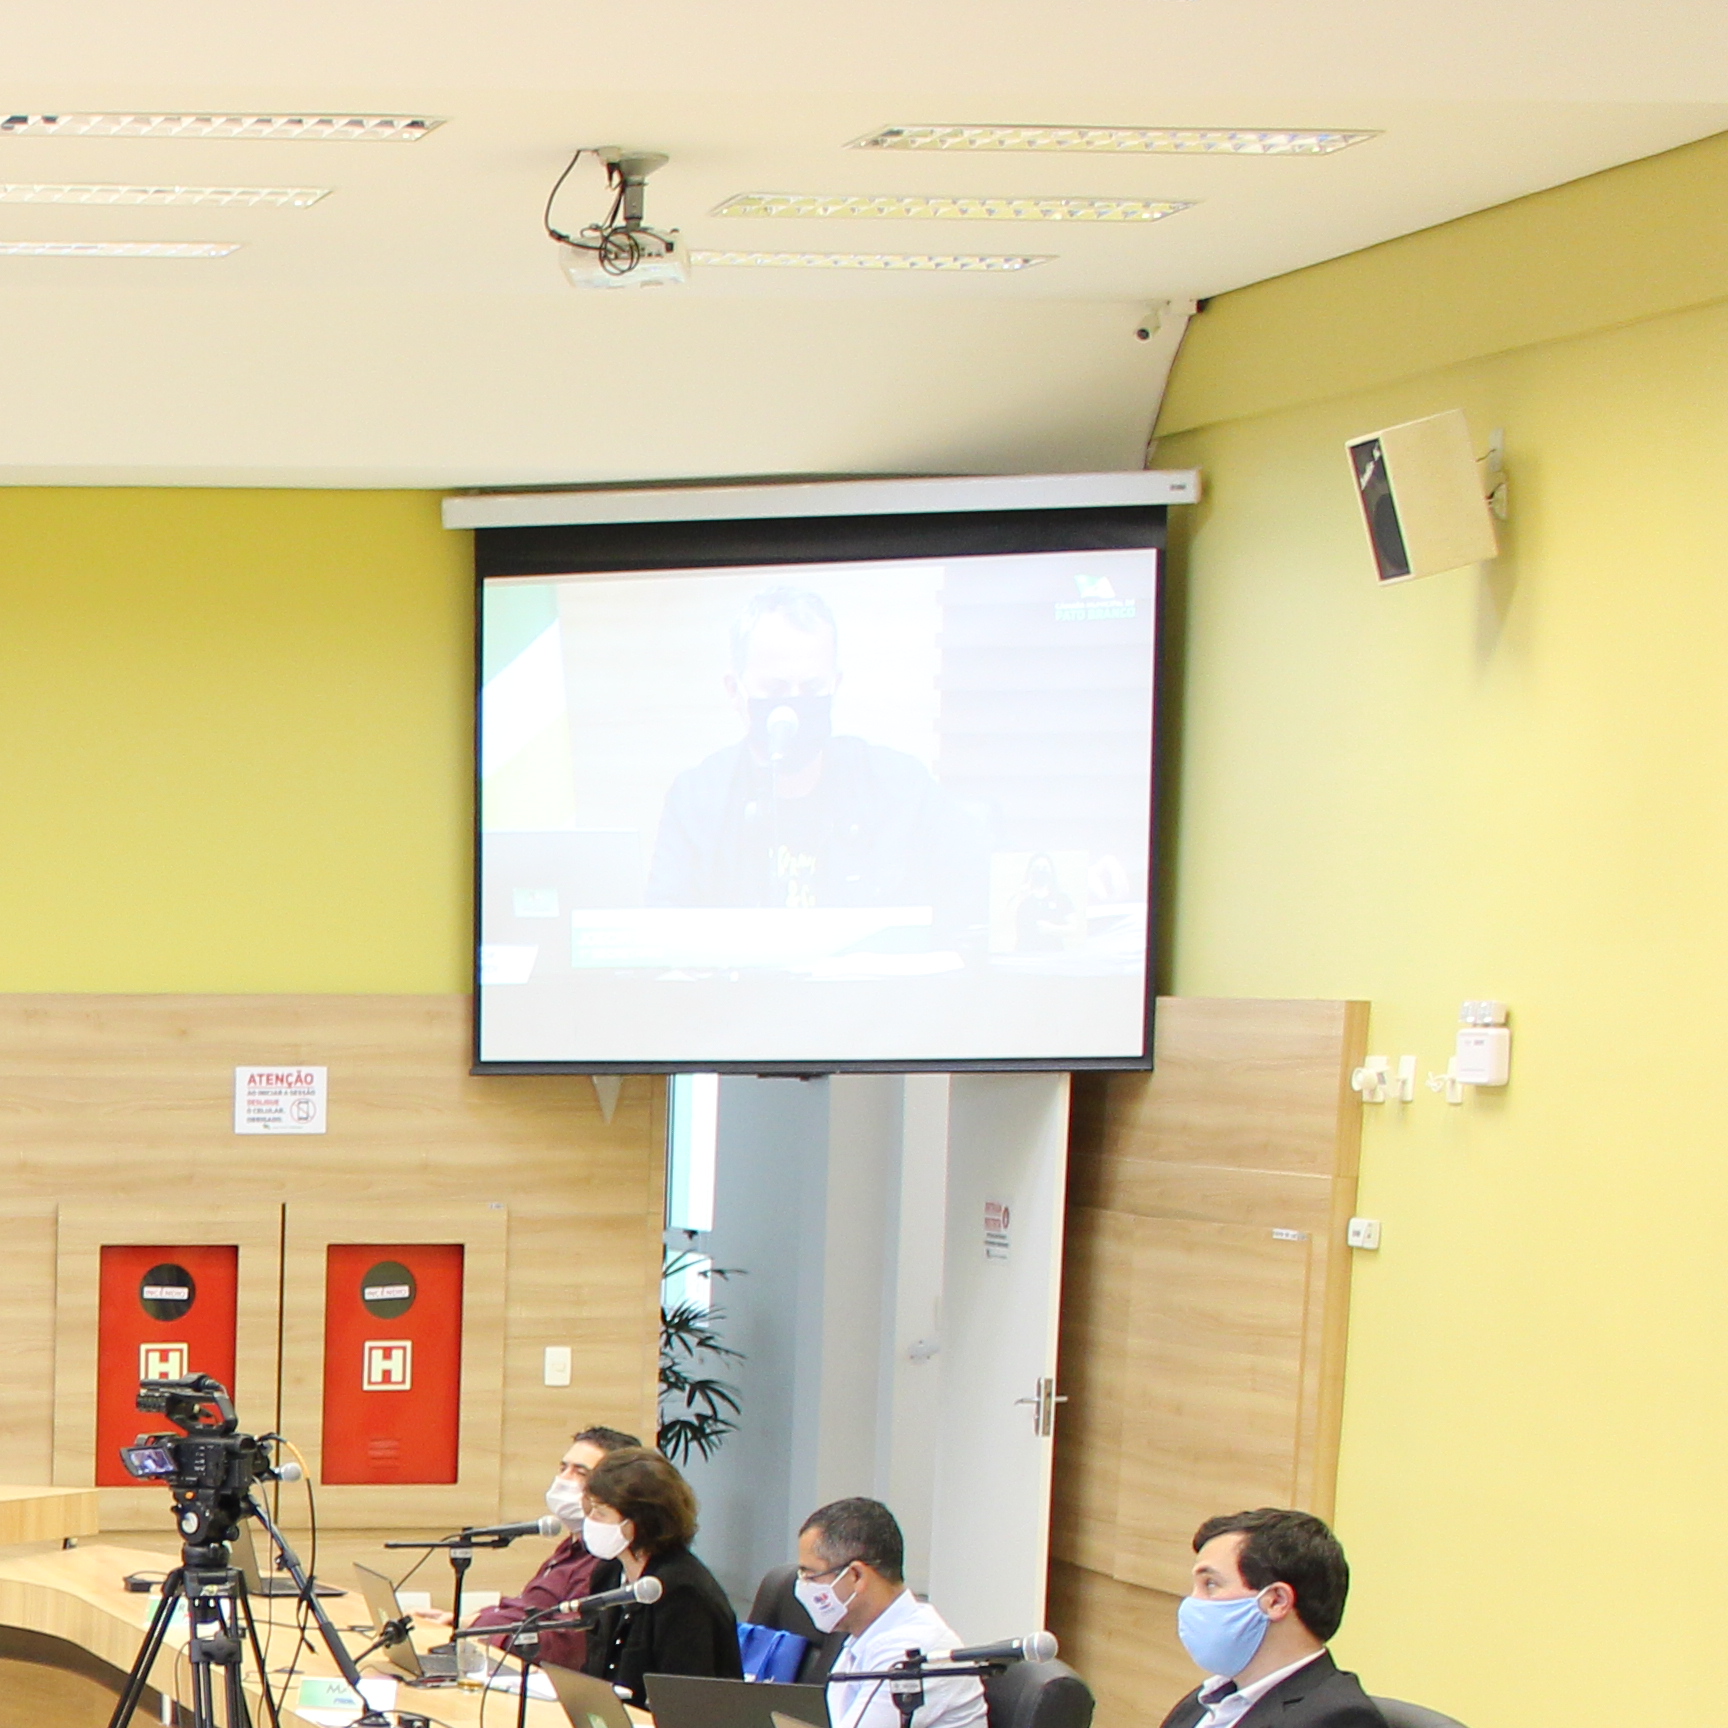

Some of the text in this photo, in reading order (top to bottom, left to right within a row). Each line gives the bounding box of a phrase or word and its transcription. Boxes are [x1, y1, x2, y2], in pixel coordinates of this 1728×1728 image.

[1055, 607, 1136, 621] PATO BRANCO
[247, 1070, 315, 1088] ATENÇÃO
[148, 1351, 181, 1380] H
[371, 1348, 402, 1382] H
